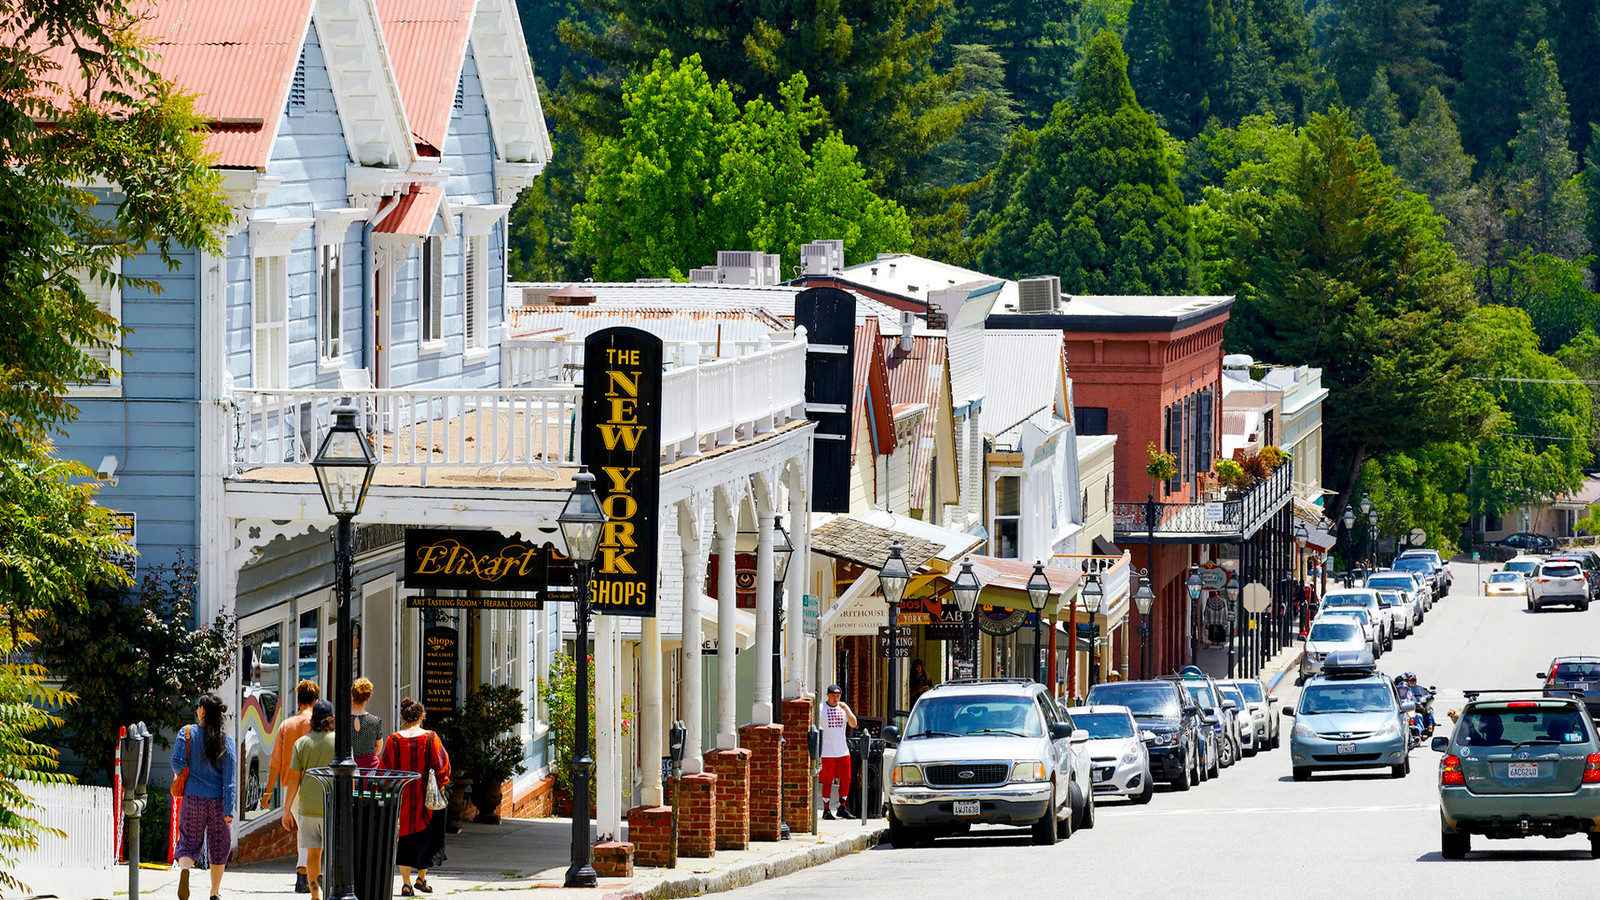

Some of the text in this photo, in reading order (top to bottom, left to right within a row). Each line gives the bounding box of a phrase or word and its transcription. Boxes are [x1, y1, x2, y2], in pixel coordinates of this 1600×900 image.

[606, 349, 640, 365] THE
[596, 370, 647, 575] NEW YORK
[414, 538, 537, 582] Elixart
[589, 579, 646, 606] SHOPS
[412, 598, 538, 608] ART TASTING ROOM HERBAL LOUNGE
[903, 614, 922, 623] YORK
[901, 627, 912, 635] TO
[427, 636, 454, 647] Shops
[881, 637, 913, 647] PAKING
[885, 648, 909, 657] SOPS
